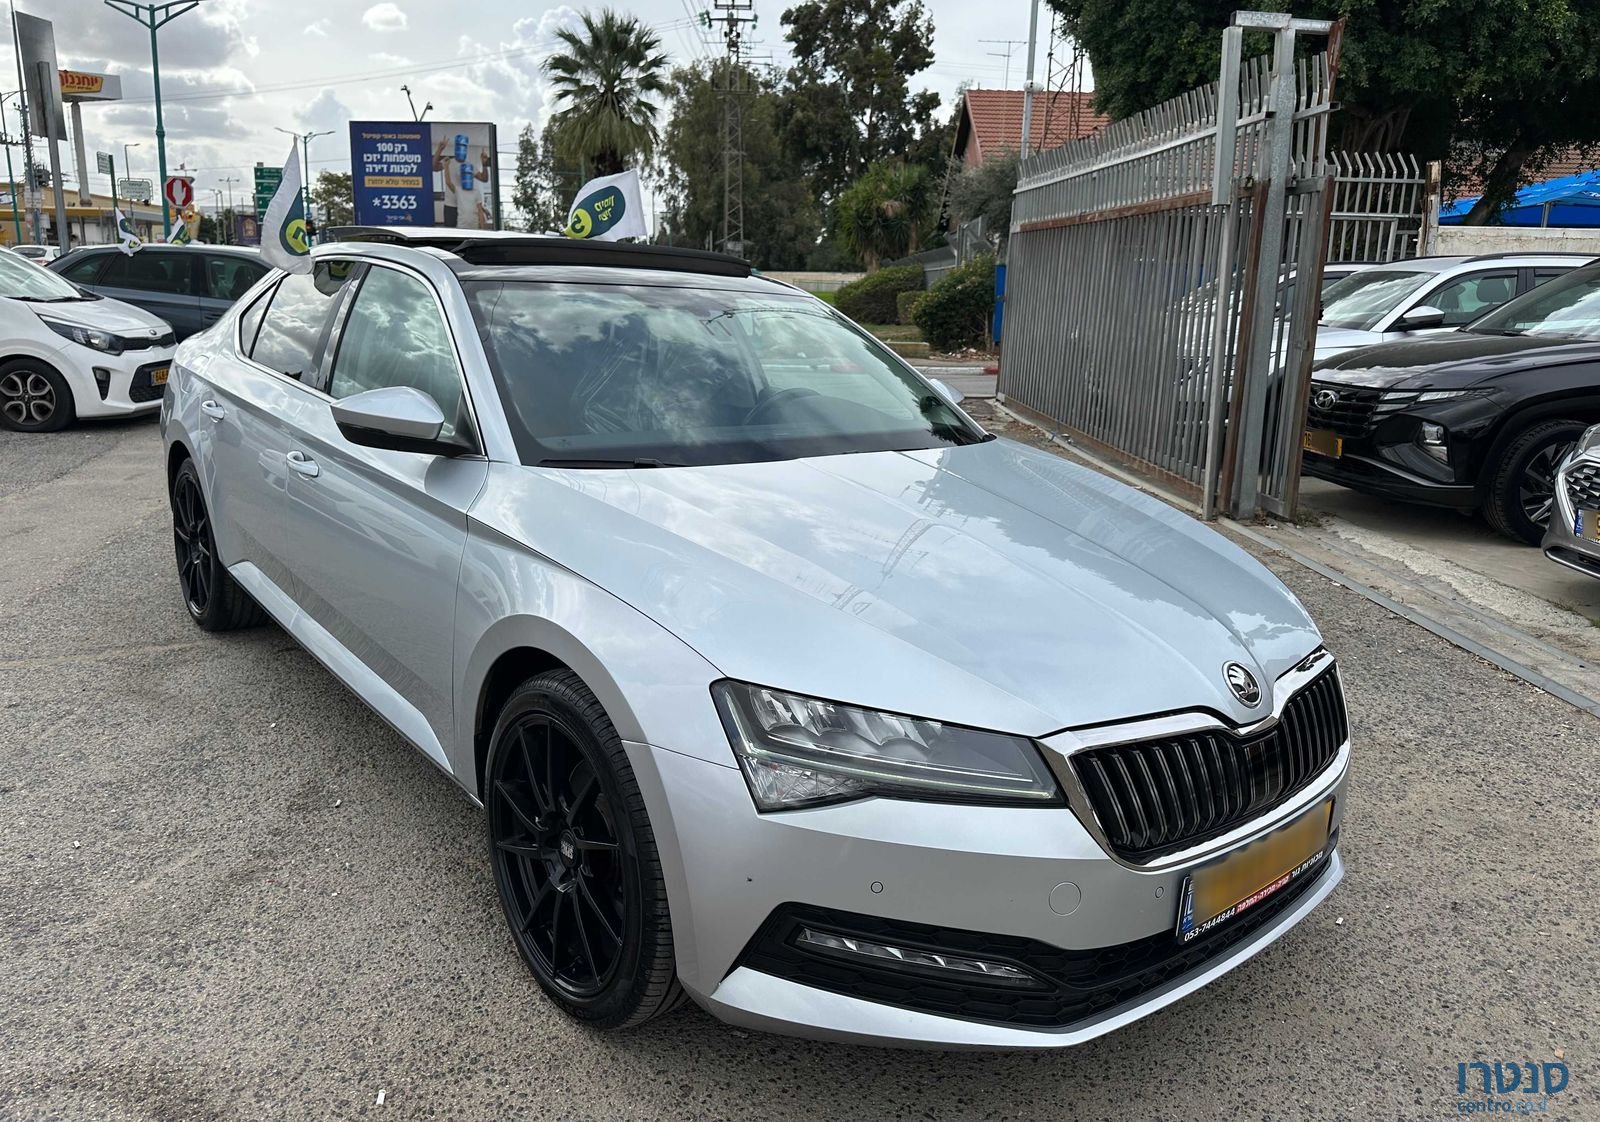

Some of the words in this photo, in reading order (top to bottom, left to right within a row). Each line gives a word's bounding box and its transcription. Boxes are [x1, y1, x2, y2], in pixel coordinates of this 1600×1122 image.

[376, 143, 394, 152] 100
[394, 143, 408, 154] רק
[382, 153, 422, 163] משפחות
[365, 164, 388, 173] דירה
[389, 163, 418, 175] לקנות
[1184, 907, 1236, 942] 053-7444844
